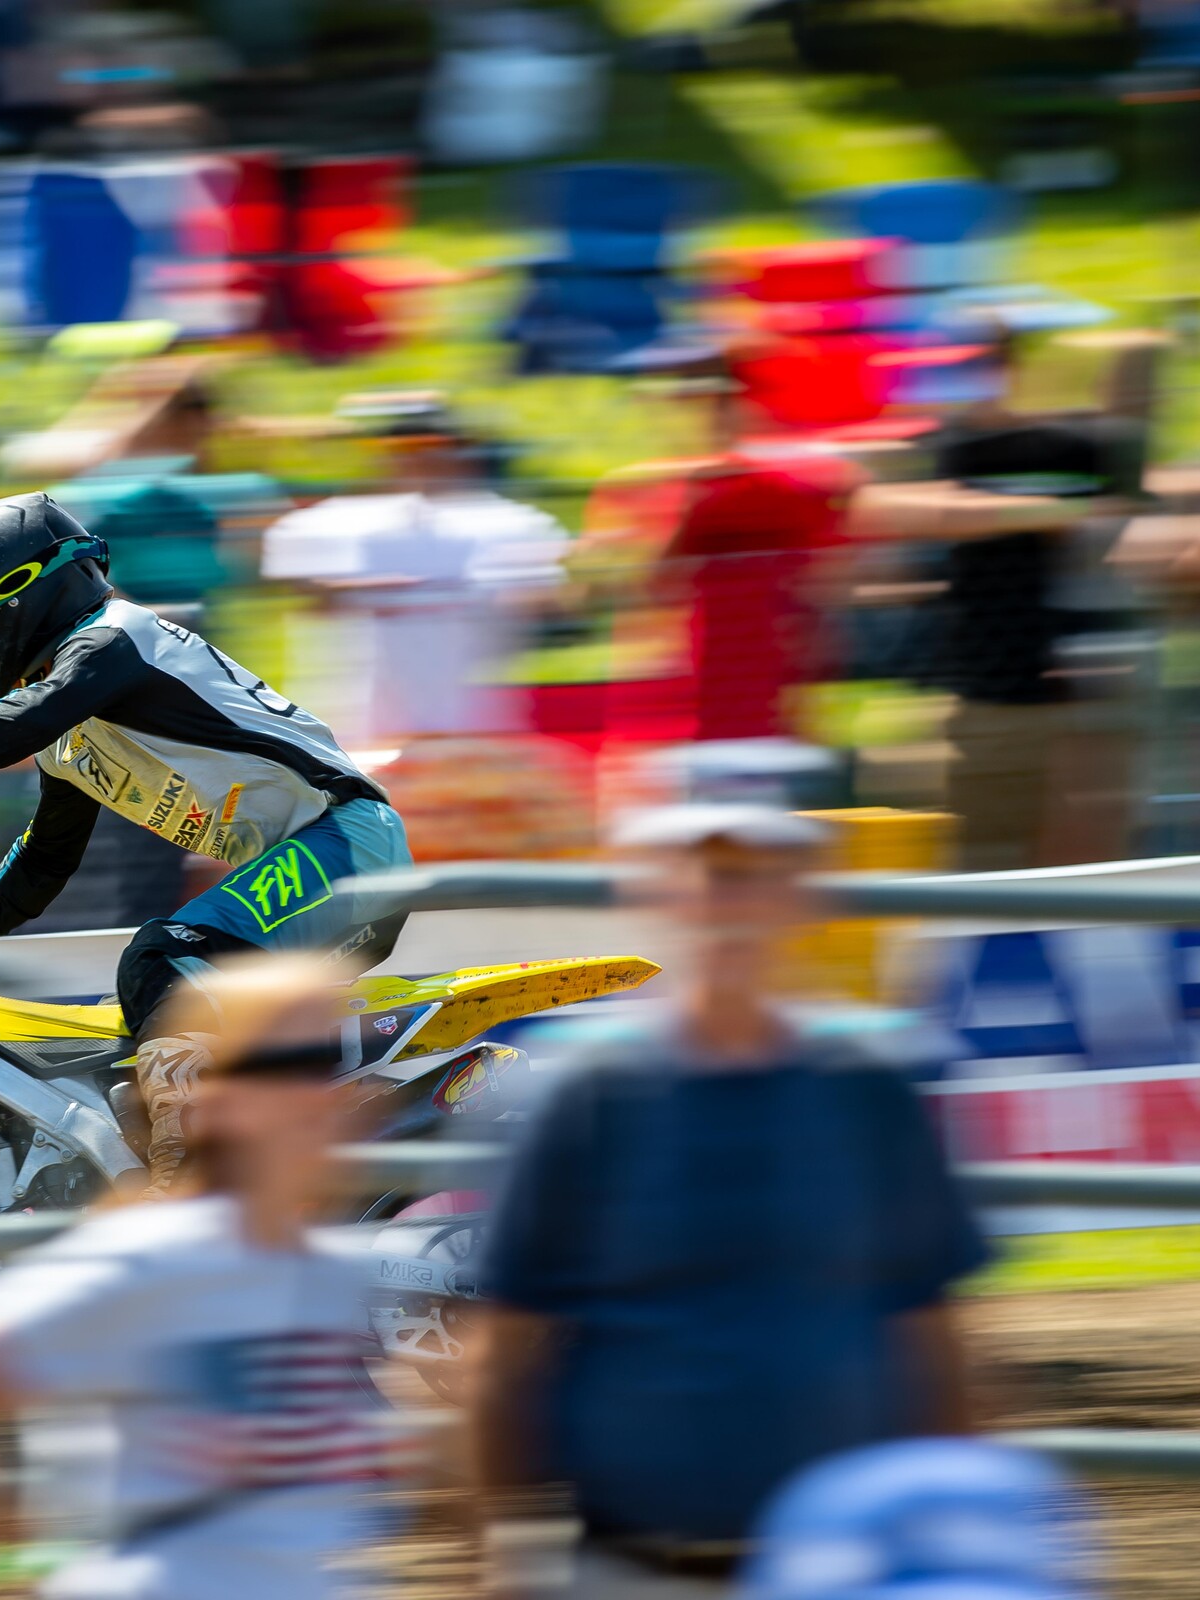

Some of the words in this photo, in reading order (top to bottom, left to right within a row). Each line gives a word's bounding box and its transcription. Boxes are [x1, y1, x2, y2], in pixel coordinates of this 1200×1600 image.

[147, 773, 186, 829] SUZUKI
[248, 847, 304, 916] FLY
[380, 1260, 433, 1284] Mika
